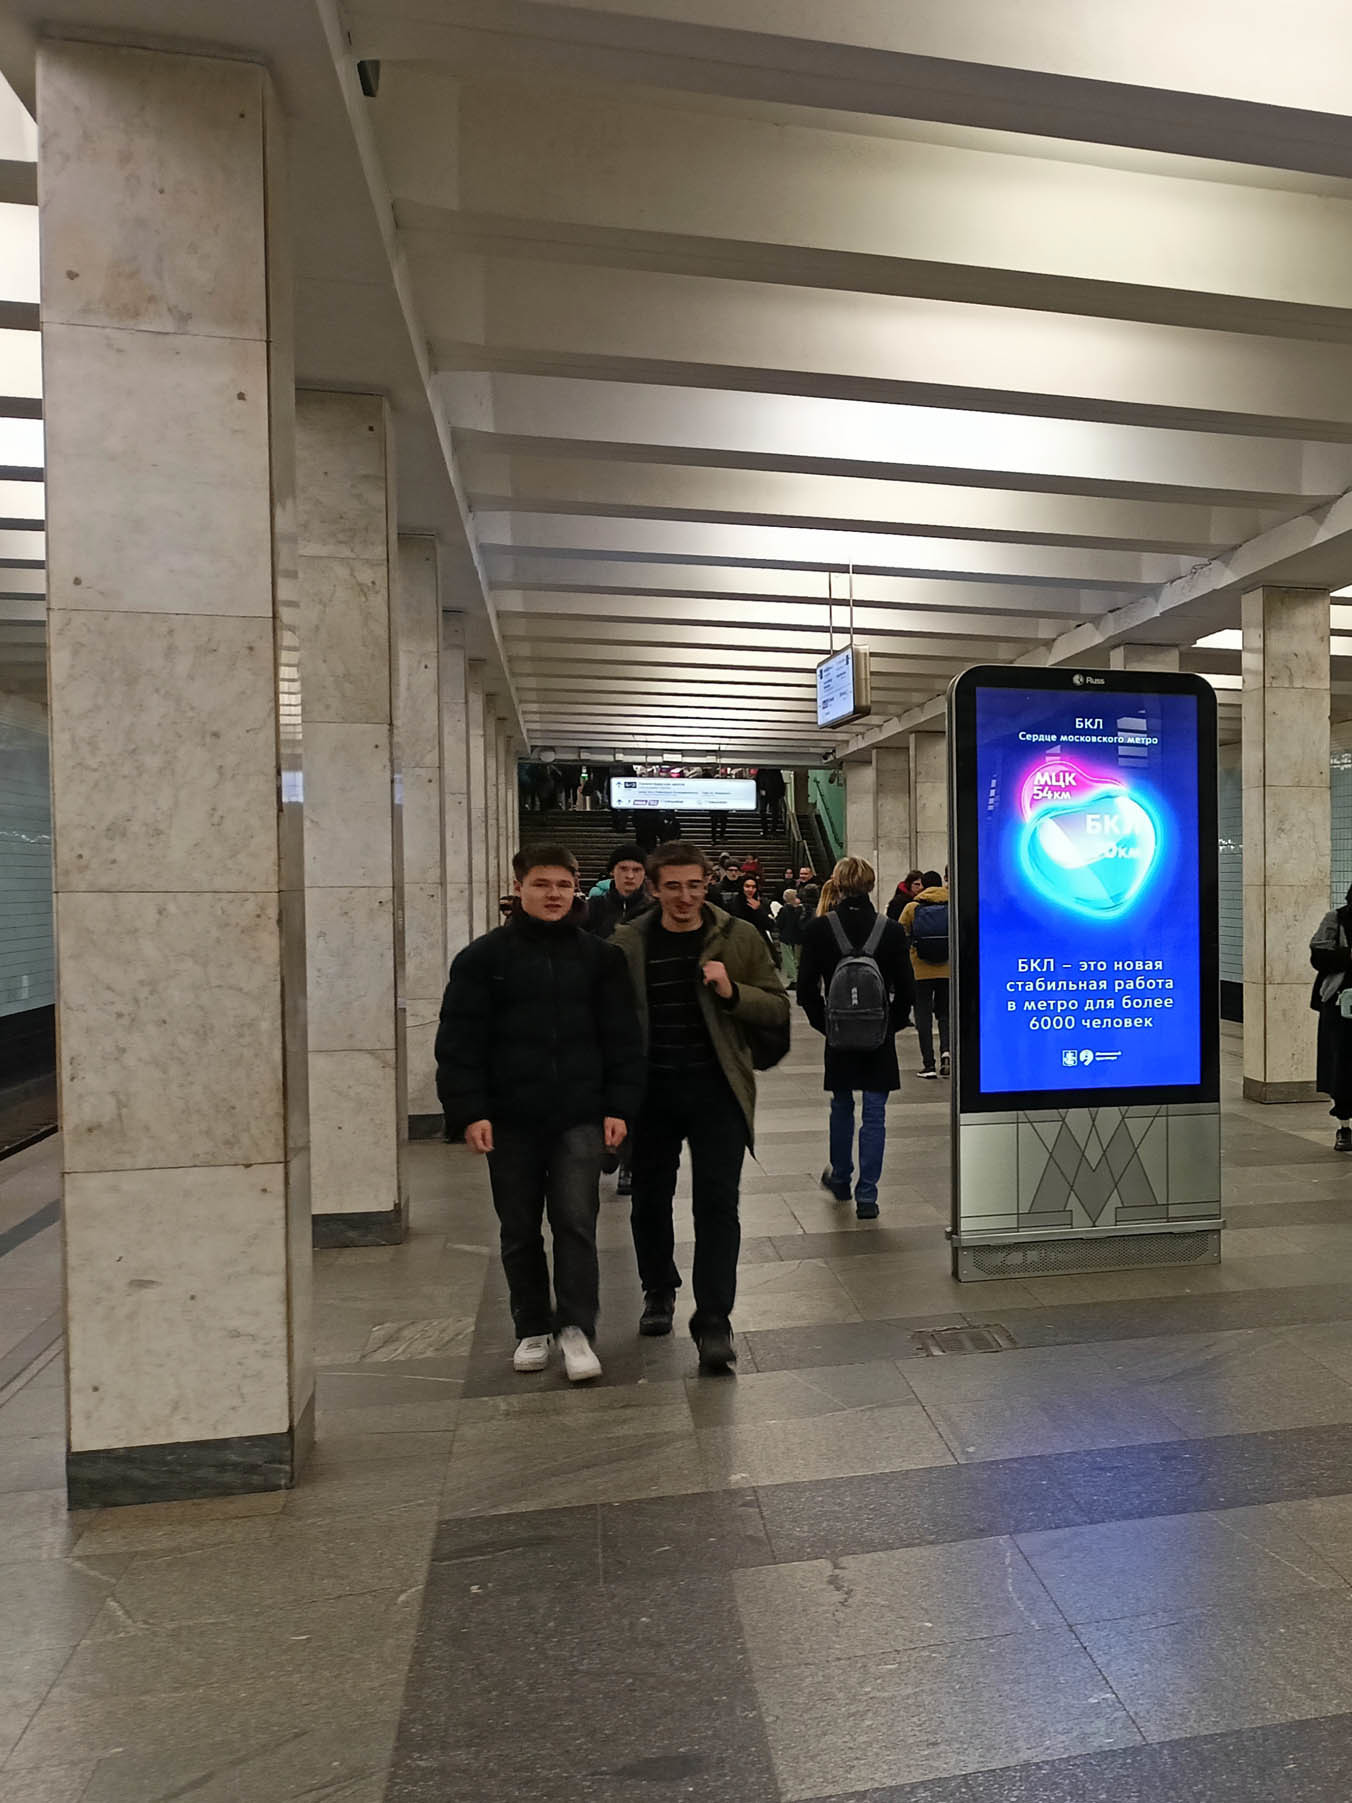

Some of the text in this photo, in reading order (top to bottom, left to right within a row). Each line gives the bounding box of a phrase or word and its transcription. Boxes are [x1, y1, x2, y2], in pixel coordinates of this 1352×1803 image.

[1075, 717, 1103, 730] БКЛ
[1018, 731, 1159, 746] Сердце московского метро
[1033, 771, 1077, 788] МЦК
[1018, 958, 1054, 973] БКЛ
[1079, 961, 1107, 972] это
[1114, 959, 1163, 971] новая
[1006, 976, 1174, 993] стабильная работа
[1007, 996, 1174, 1013] в метро для более
[1029, 1015, 1153, 1030] 6000 человек
